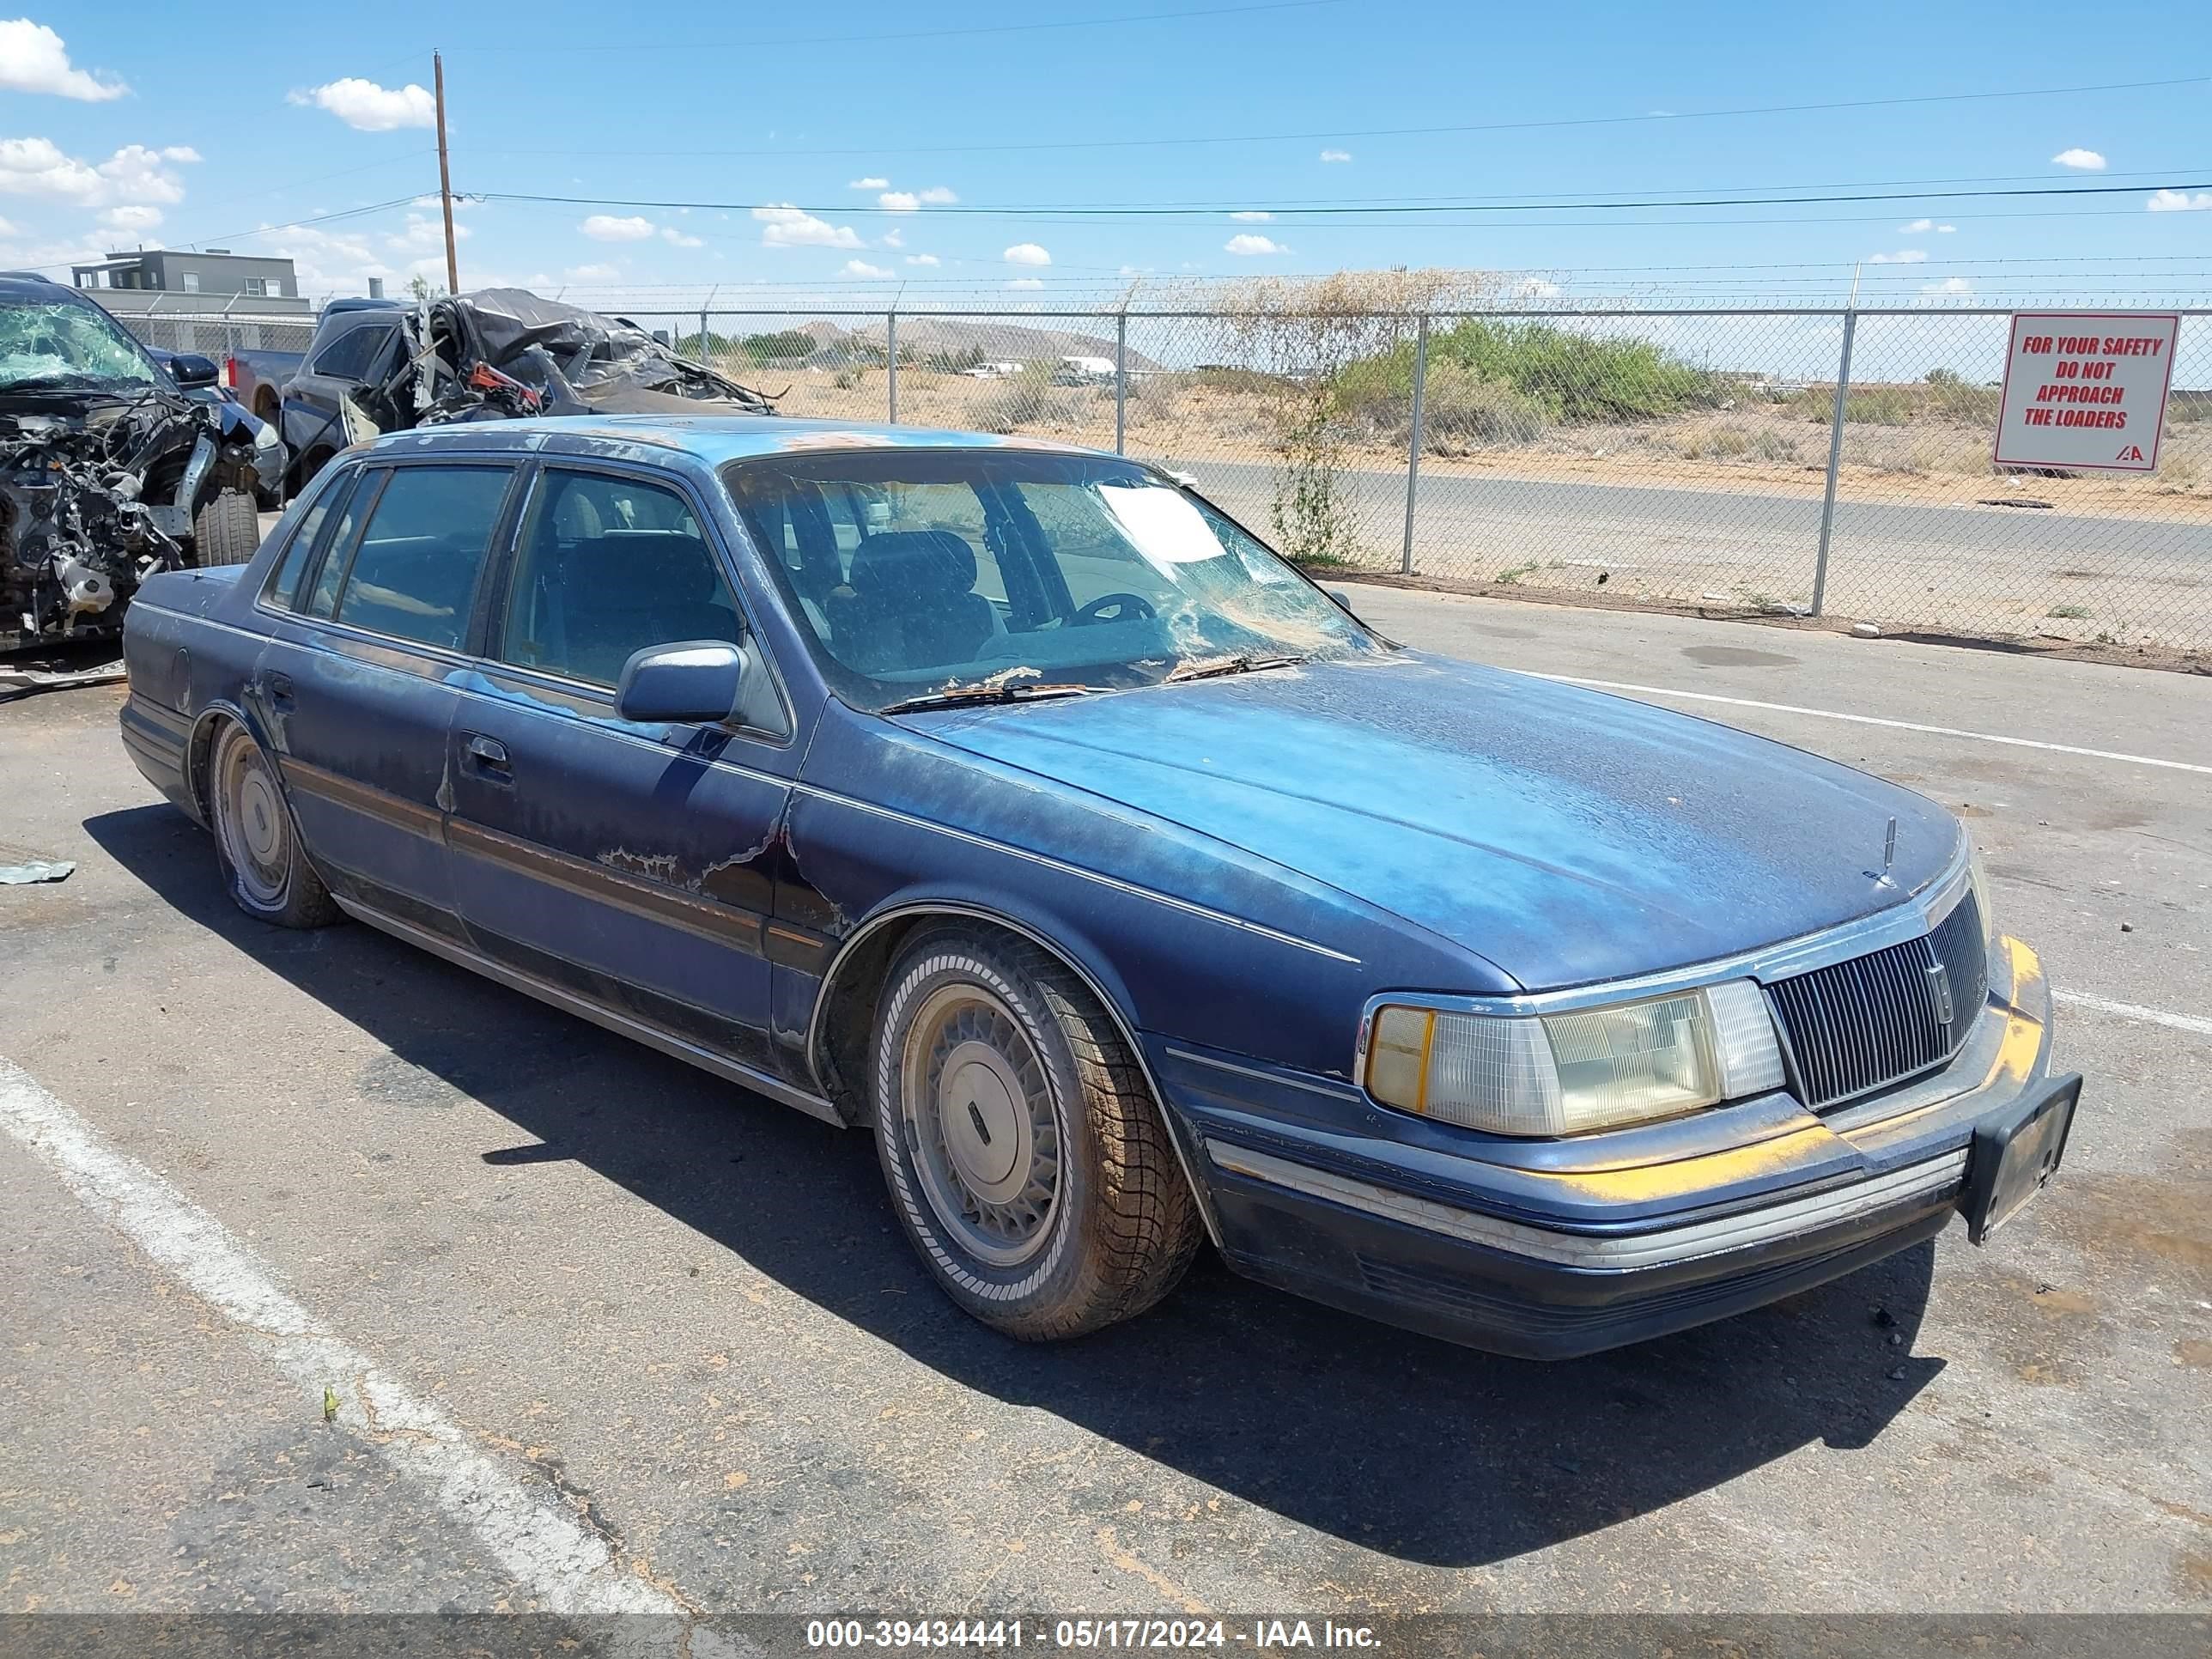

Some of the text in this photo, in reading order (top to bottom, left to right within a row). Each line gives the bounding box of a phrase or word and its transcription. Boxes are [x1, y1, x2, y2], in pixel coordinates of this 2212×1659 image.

[2022, 337, 2163, 356] FOR YOUR SAFETY
[2056, 362, 2116, 380] DO NOT
[2036, 385, 2124, 404] APPROACH
[2025, 409, 2127, 429] THE LOADERS
